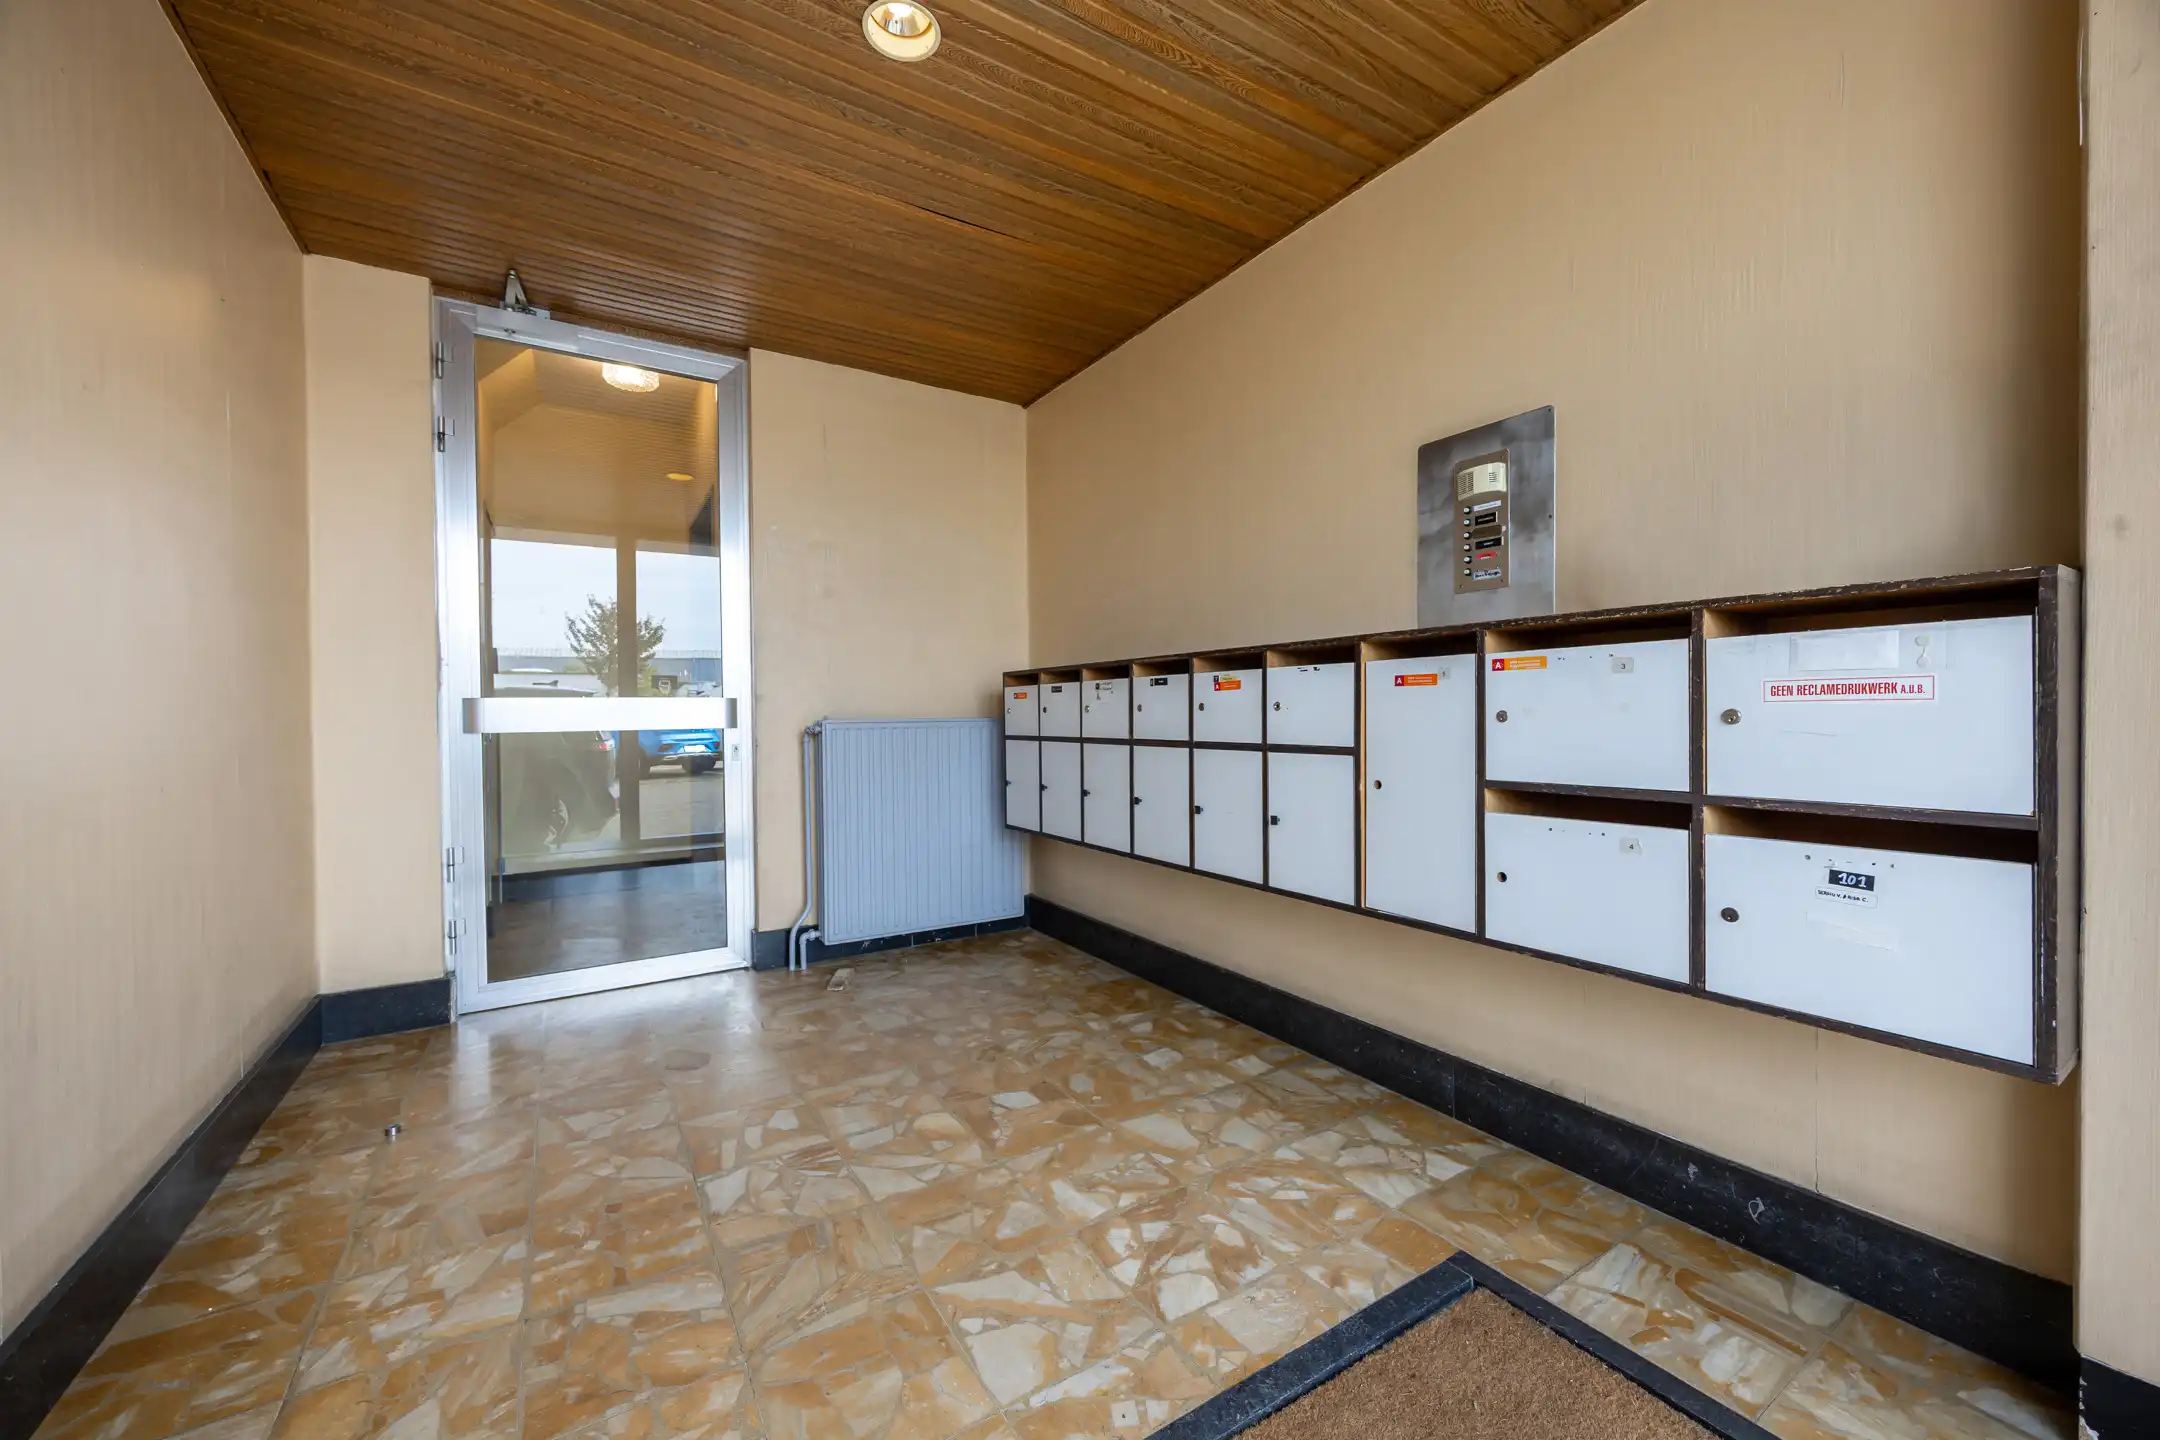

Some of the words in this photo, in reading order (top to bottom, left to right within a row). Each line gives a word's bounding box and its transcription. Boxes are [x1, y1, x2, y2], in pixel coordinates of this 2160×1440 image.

[1770, 685, 1794, 696] GEEN
[1796, 682, 1898, 696] RECLAMEDRUKWERK
[1900, 684, 1926, 694] A.U.B.
[1838, 872, 1866, 888] 101
